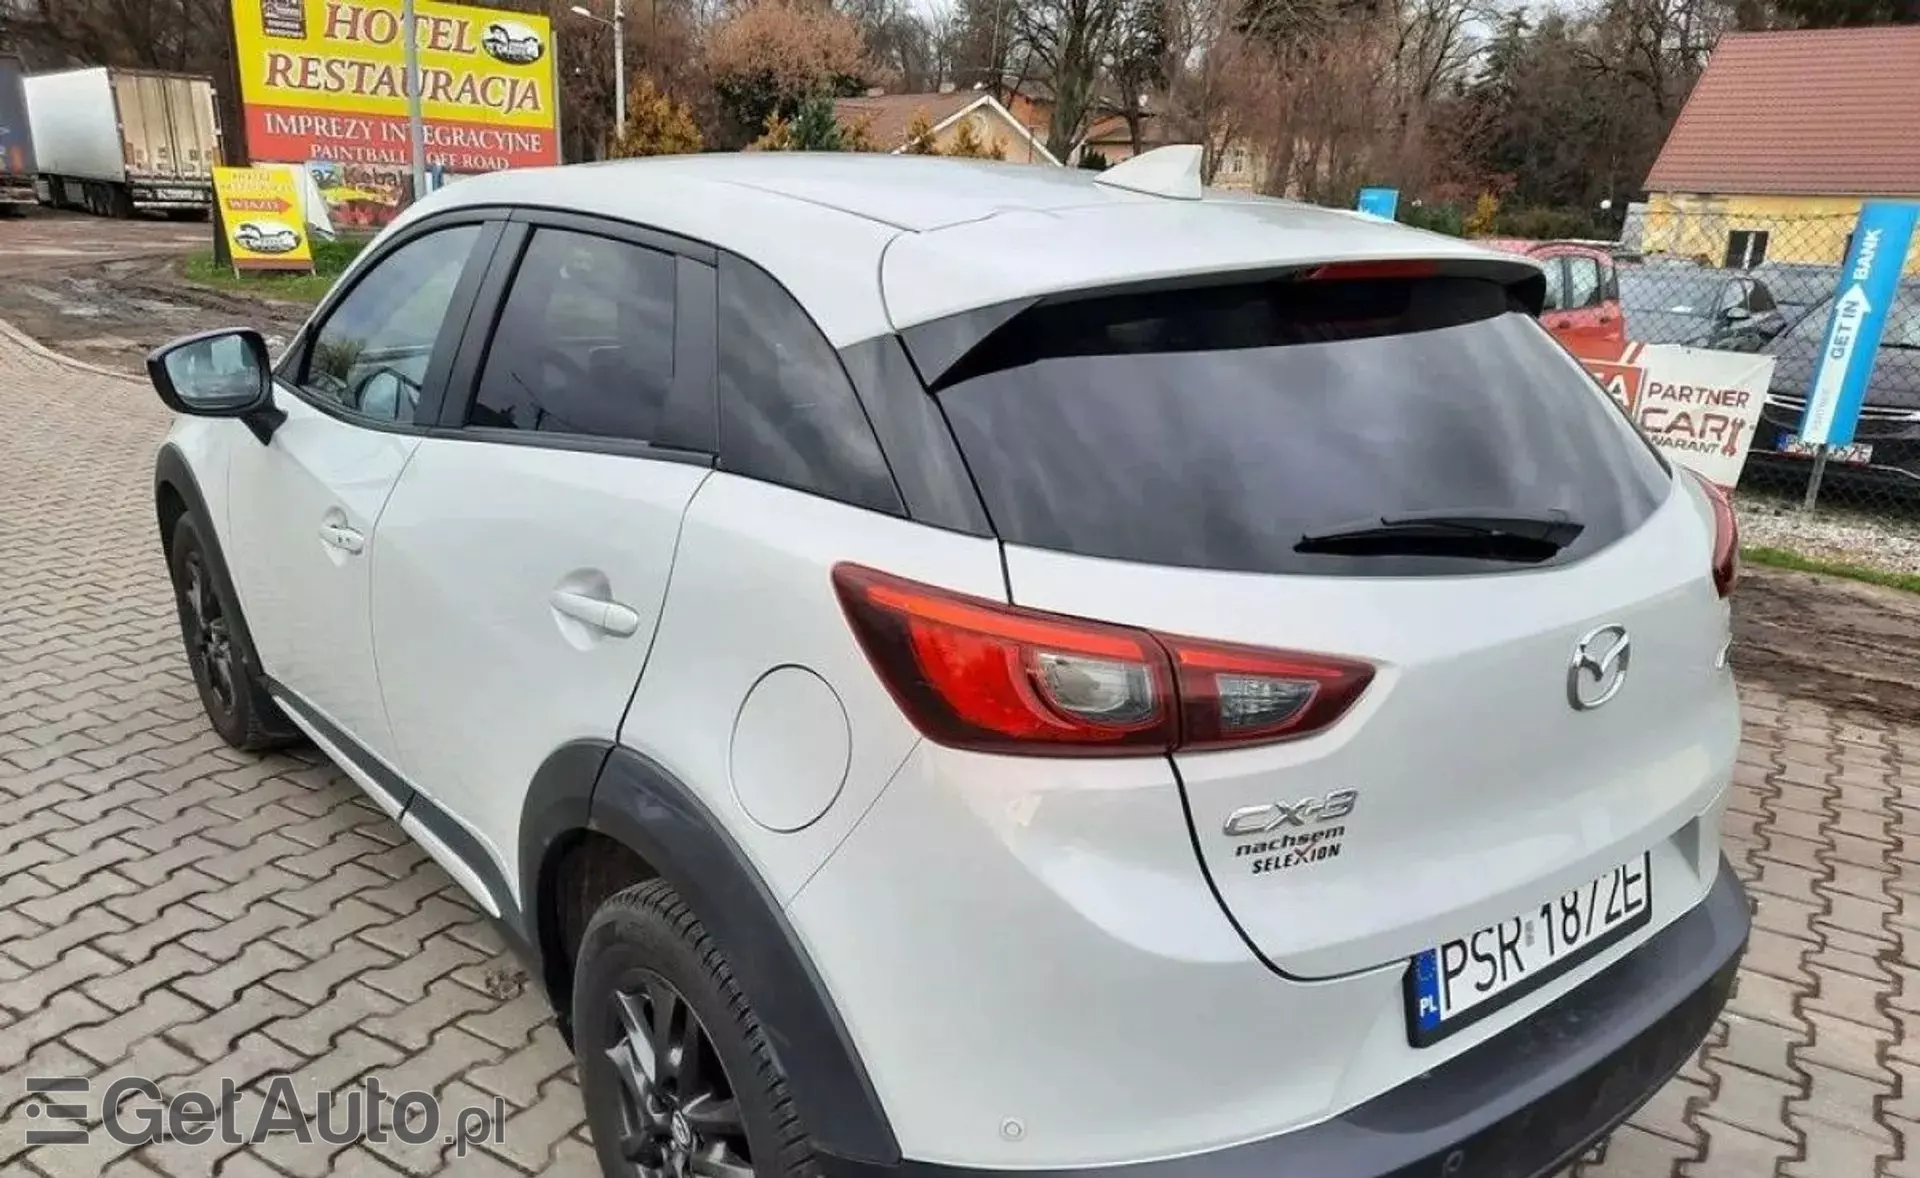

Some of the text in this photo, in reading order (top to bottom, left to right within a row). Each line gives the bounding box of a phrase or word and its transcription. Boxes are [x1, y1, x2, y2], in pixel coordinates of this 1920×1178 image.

[323, 2, 477, 54] HOTEL
[264, 52, 542, 115] RESTAURACJA
[265, 112, 543, 153] IMPREZY INEGRACYJNE
[1830, 228, 1883, 361] GET IN BANK
[1648, 381, 1751, 409] PARTNER
[1640, 406, 1729, 442] CAR
[1222, 786, 1359, 837] CX-3
[1235, 826, 1345, 857] nachsem
[1251, 840, 1342, 875] SELEXION
[1441, 916, 1526, 1011] PSR
[1419, 994, 1438, 1019] PL
